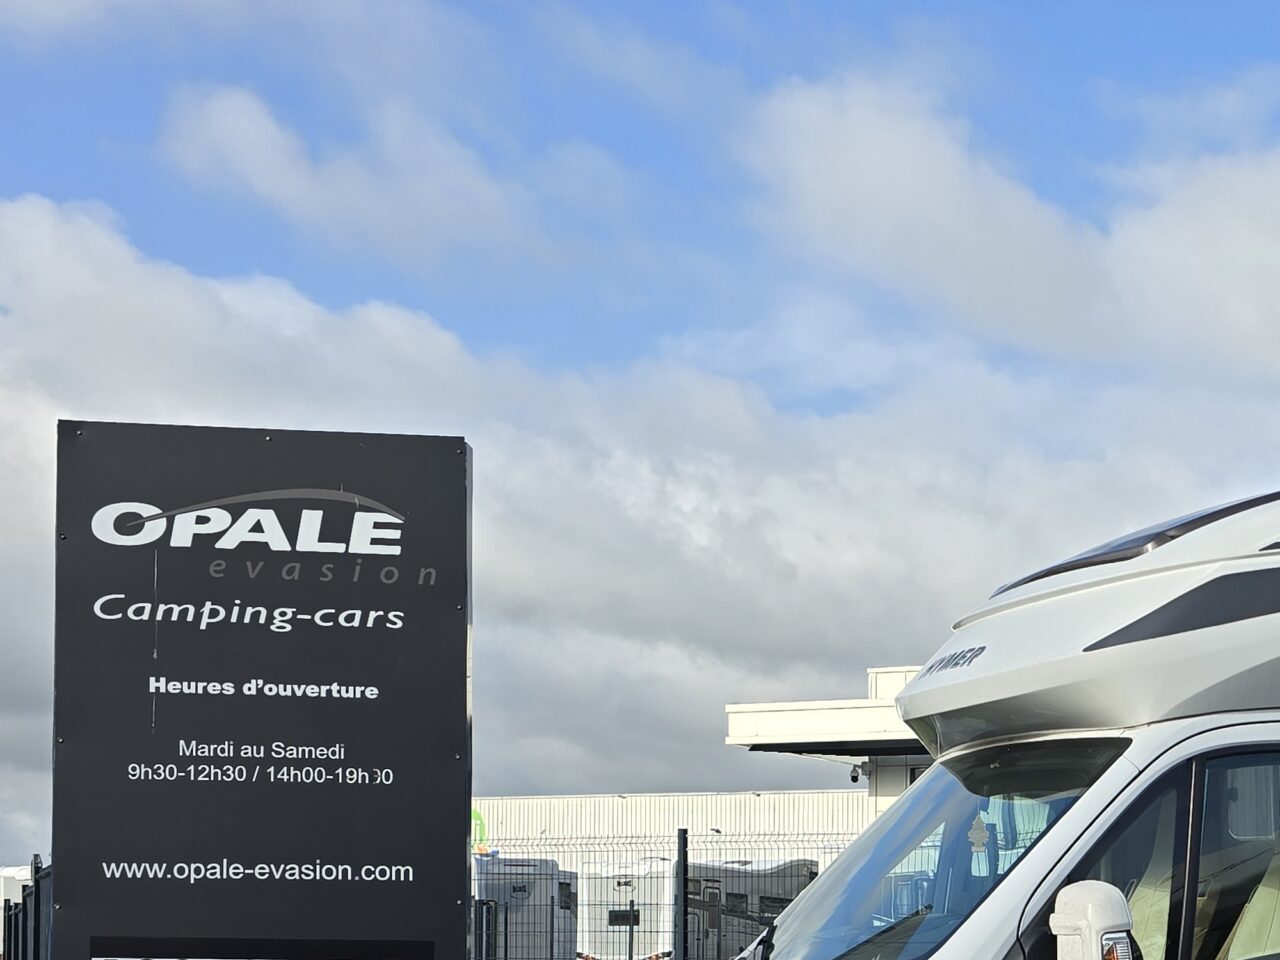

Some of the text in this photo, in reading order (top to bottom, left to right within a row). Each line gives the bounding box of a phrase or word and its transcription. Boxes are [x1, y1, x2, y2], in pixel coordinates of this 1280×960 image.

[91, 502, 402, 555] OPALE
[208, 558, 437, 586] evasion
[93, 594, 405, 632] Camping-cars
[149, 677, 379, 699] Heures d'ouverture
[179, 740, 345, 759] Mardi au Samedi
[128, 764, 247, 782] 9h30-12h30
[102, 859, 413, 884] www.opale-evasion.com
